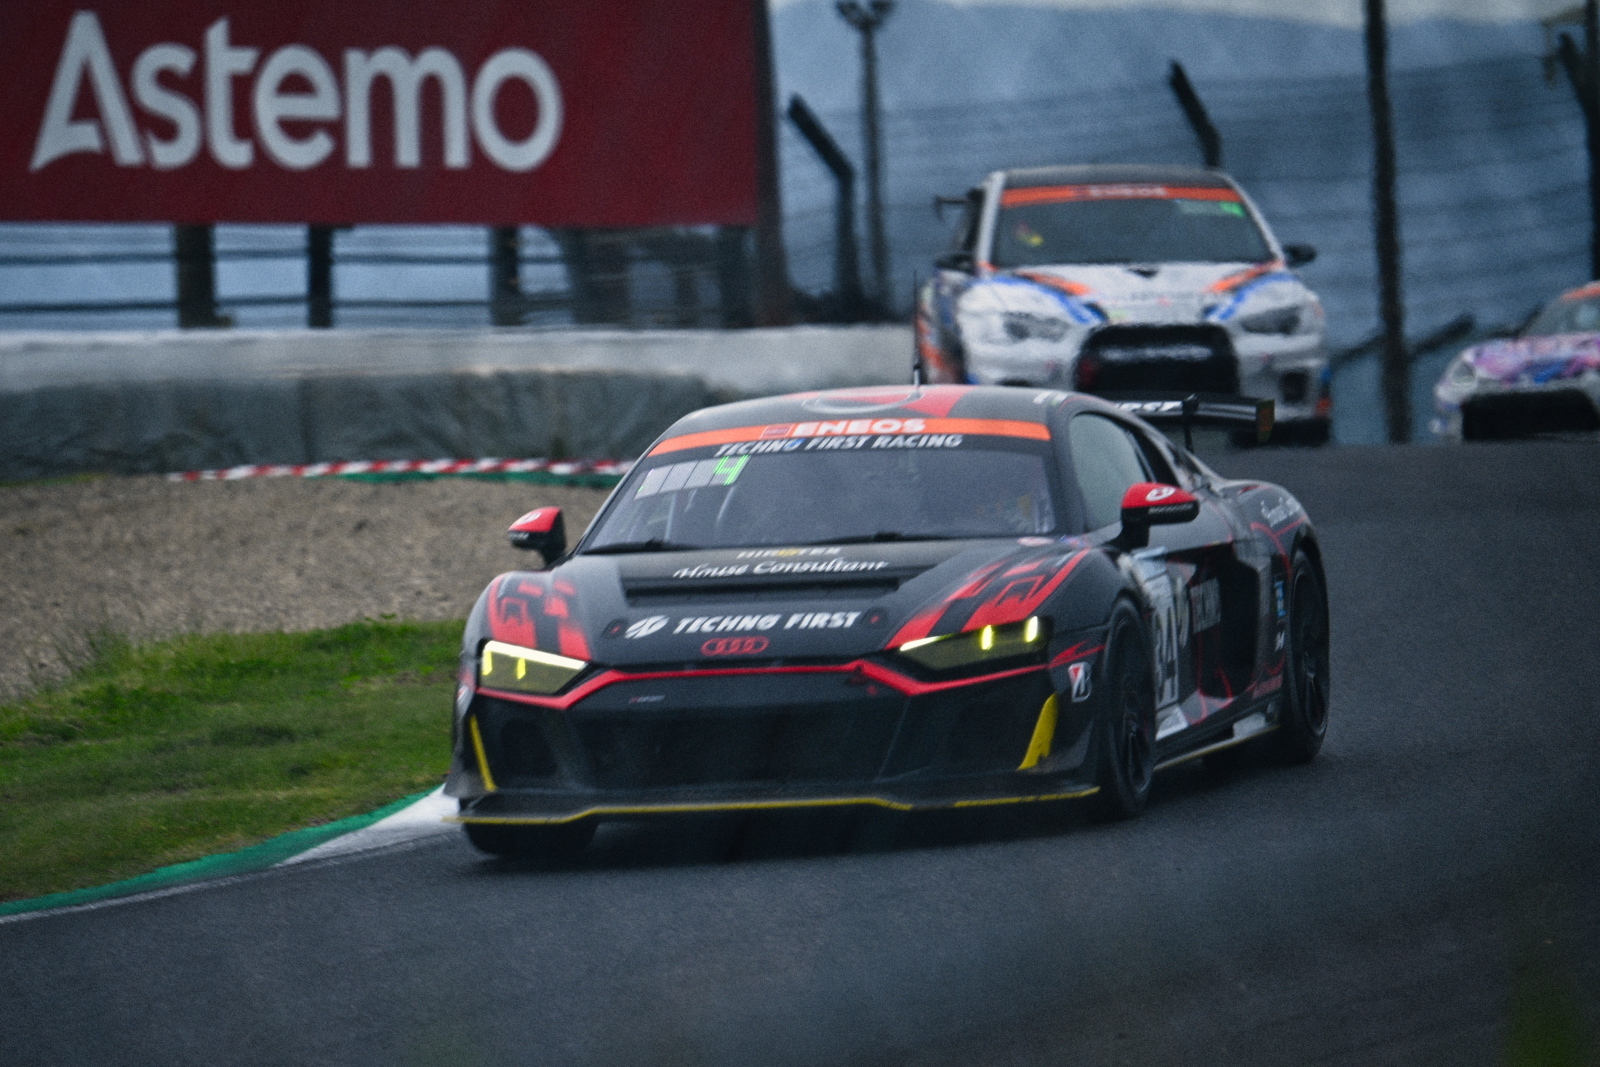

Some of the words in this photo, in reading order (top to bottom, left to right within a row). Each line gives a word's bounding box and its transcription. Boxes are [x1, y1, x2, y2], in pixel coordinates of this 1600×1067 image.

[30, 9, 564, 172] Astemo
[792, 418, 927, 437] ENEOS
[713, 437, 806, 458] TECHNO
[803, 434, 873, 450] FIRST
[871, 433, 964, 449] RACING
[713, 455, 749, 486] 4
[752, 556, 889, 575] Consultant
[672, 613, 783, 635] TECHNO
[783, 611, 862, 630] FIRST
